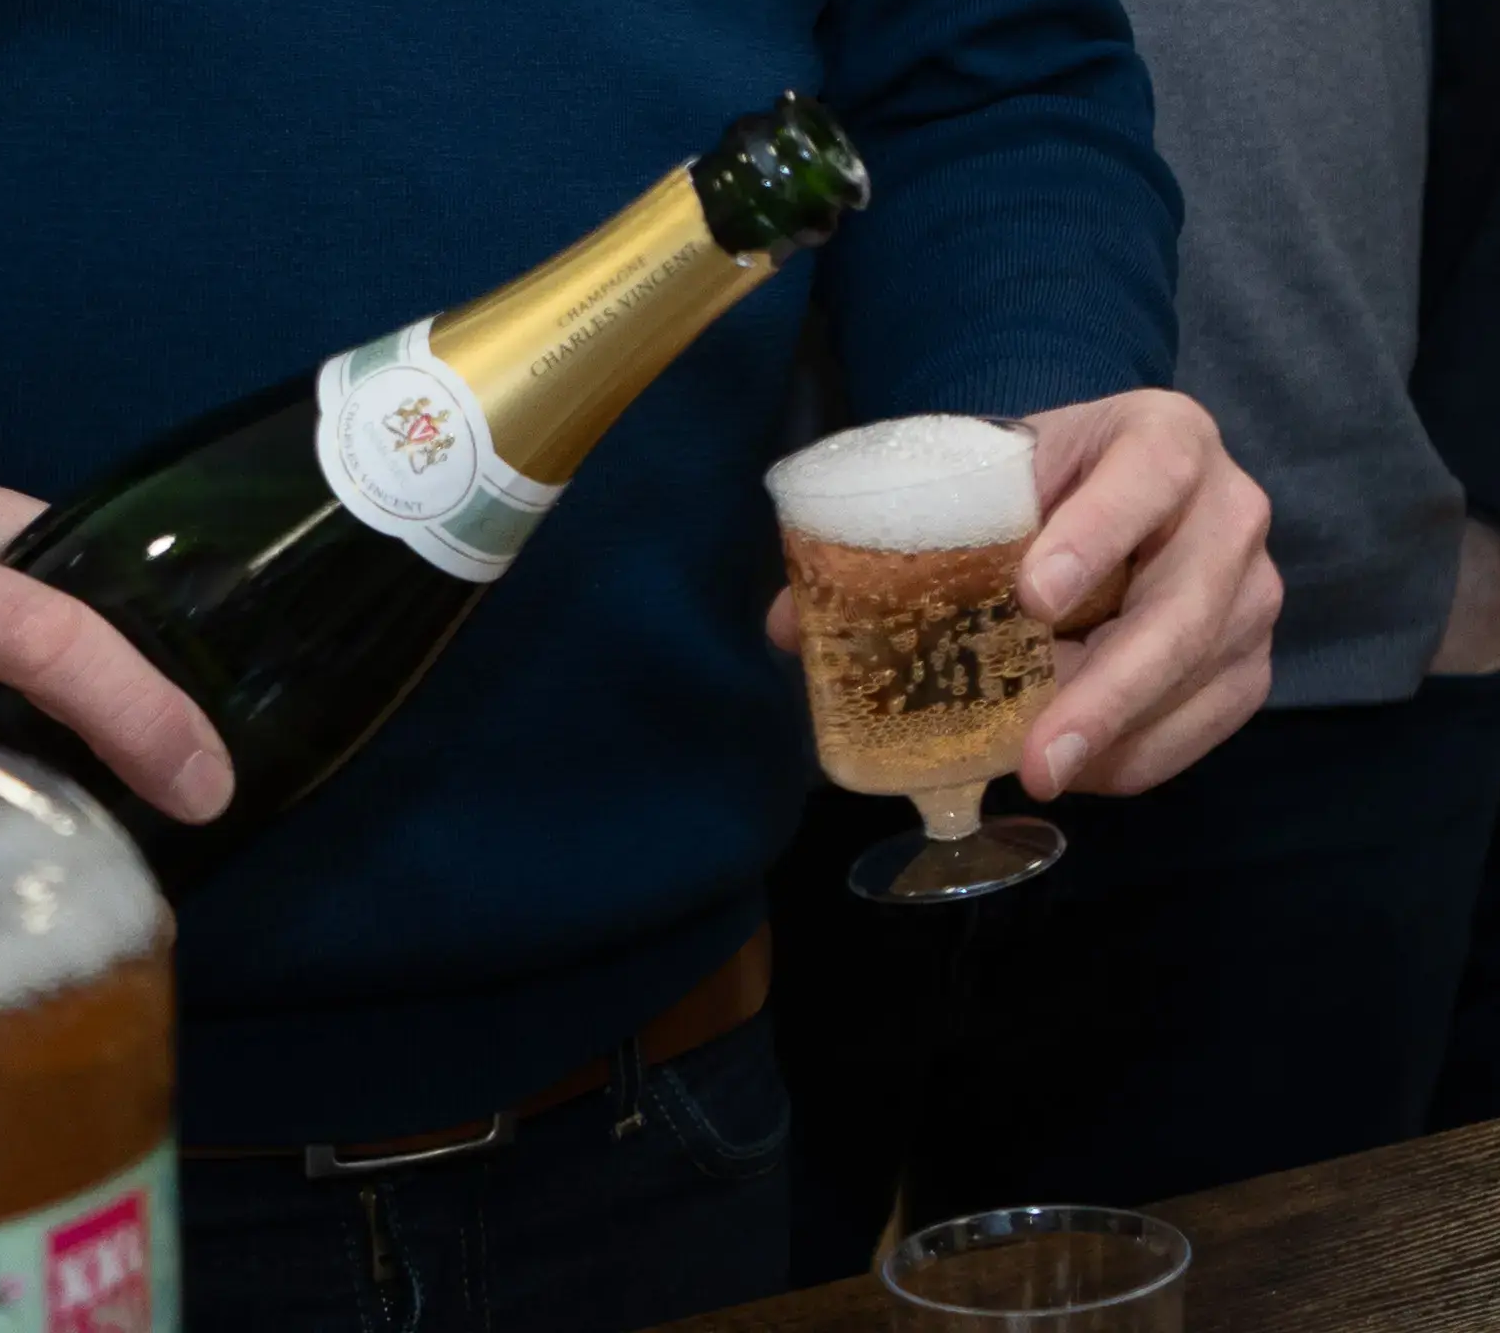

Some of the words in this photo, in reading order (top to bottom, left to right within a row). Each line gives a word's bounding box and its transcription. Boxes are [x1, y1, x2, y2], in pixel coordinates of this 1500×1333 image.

[529, 305, 619, 379] CHARLES
[617, 240, 701, 312] VINCENT
[557, 252, 649, 329] CHAMPAGNE
[342, 401, 360, 470] CHARLES
[360, 474, 424, 514] VINCENT
